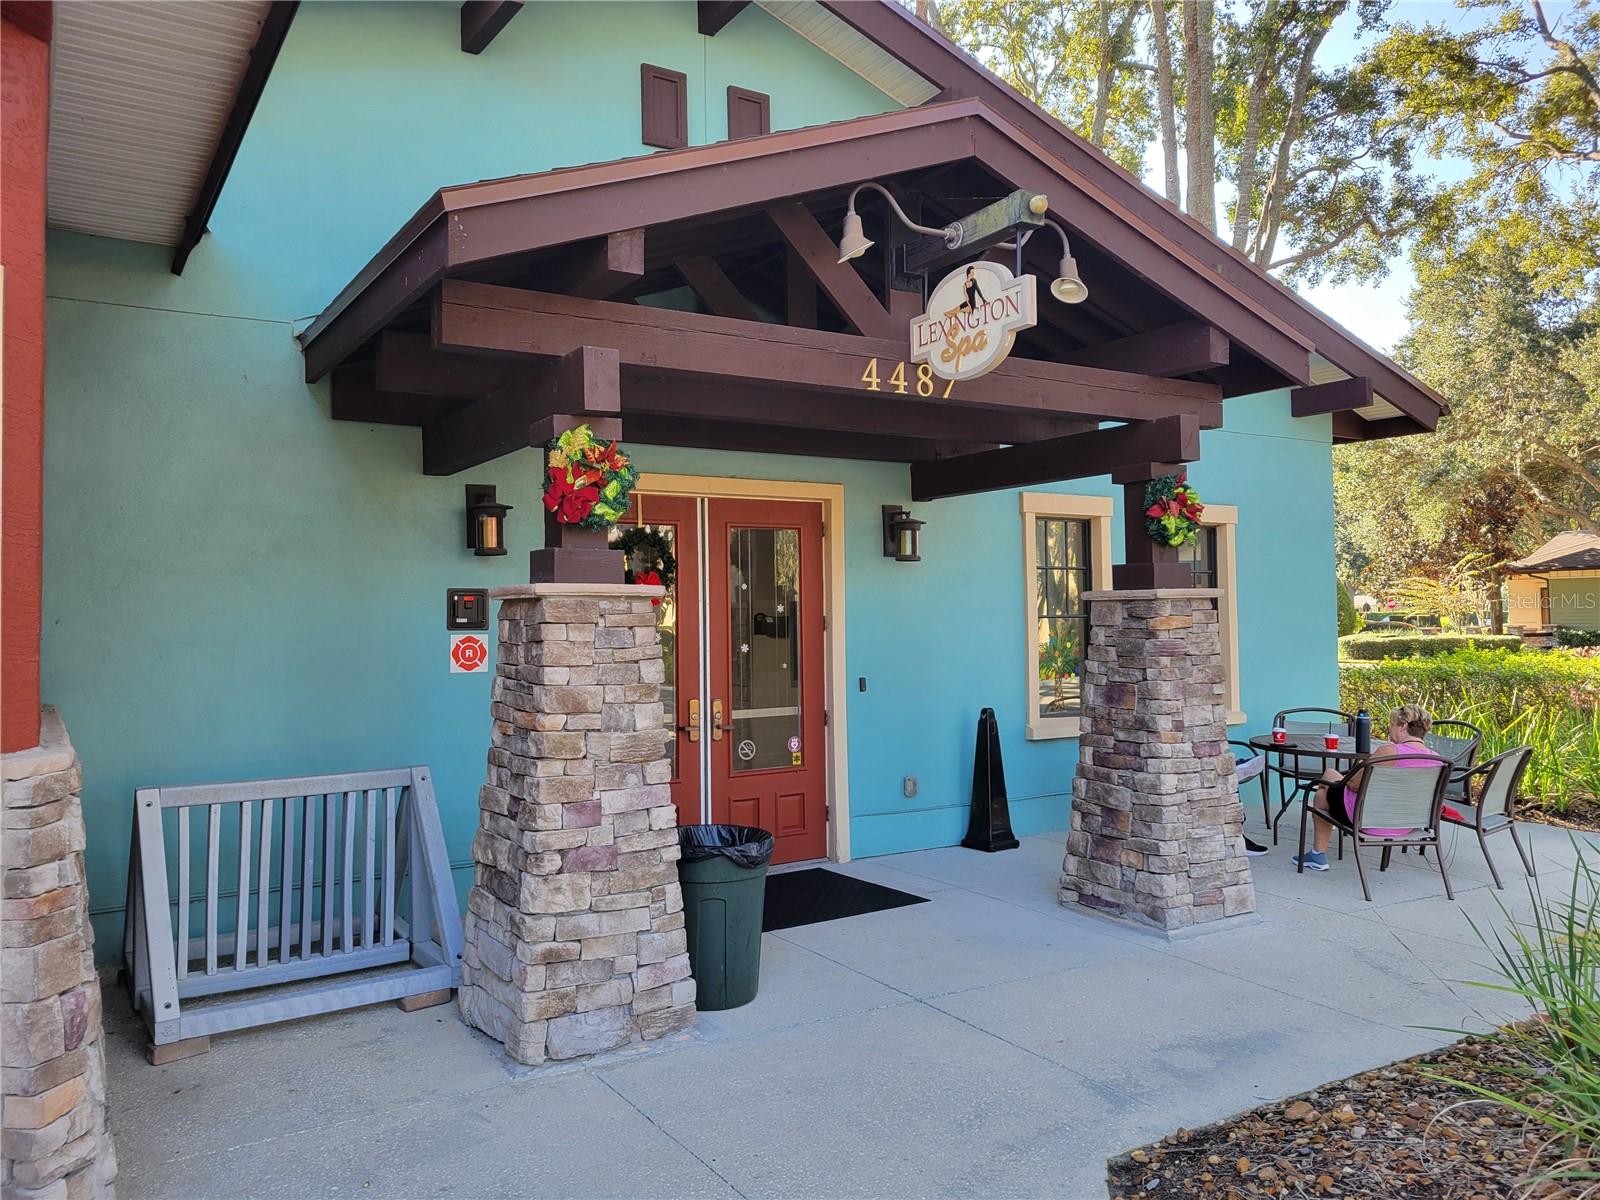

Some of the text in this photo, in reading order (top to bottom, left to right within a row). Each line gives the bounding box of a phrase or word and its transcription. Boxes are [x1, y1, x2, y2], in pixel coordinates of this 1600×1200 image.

[918, 291, 1021, 347] LEXINGTON
[940, 323, 989, 372] Spa
[465, 649, 474, 658] R
